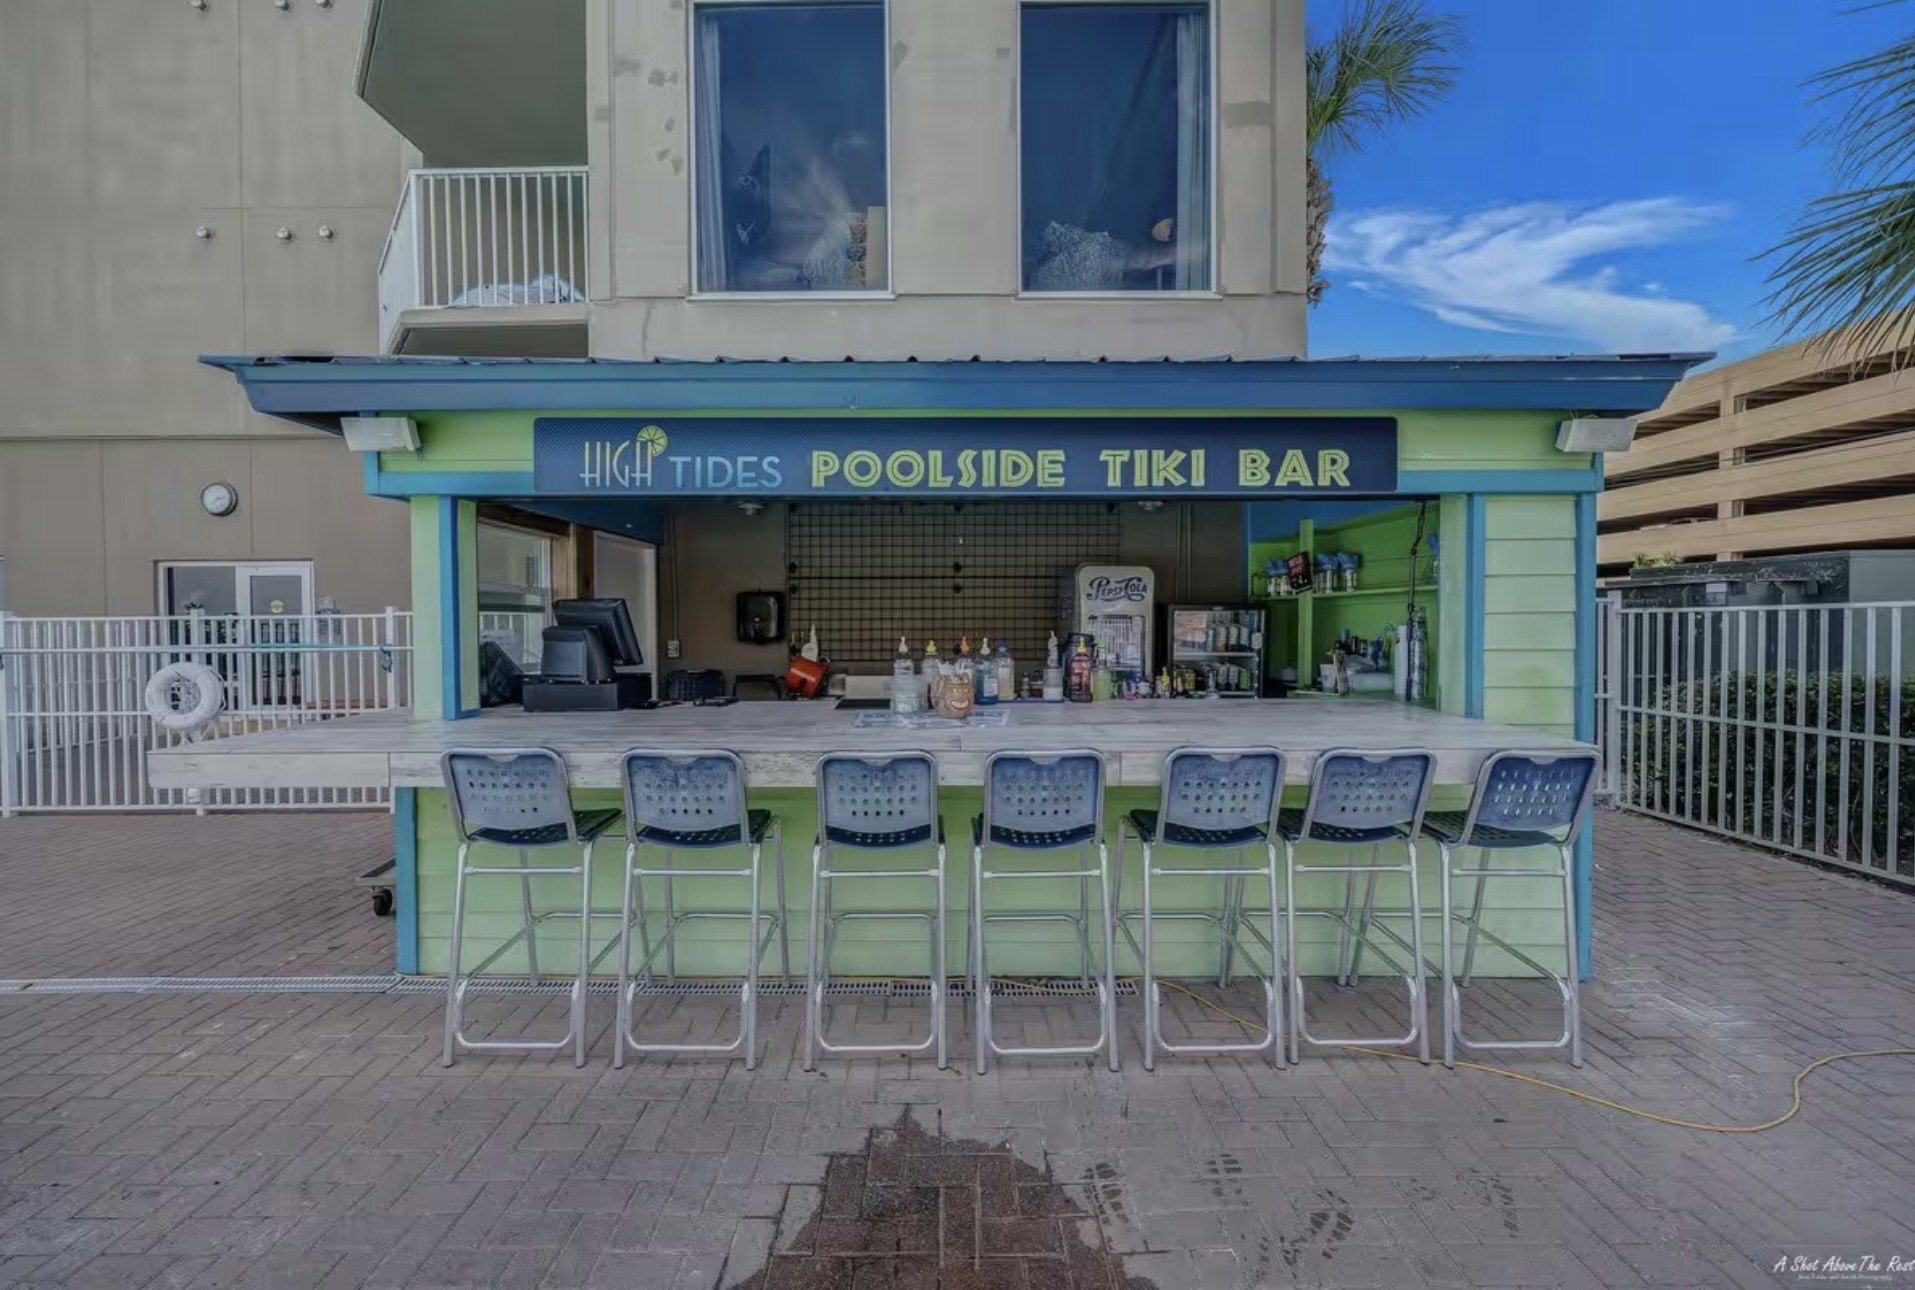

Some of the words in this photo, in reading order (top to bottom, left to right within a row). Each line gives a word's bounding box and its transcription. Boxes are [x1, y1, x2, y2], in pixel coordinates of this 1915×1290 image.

[579, 440, 653, 488] HIGH
[669, 455, 783, 488] TIDES
[812, 449, 1066, 488] POOLSIDE
[1099, 449, 1206, 487] TIKI
[1238, 449, 1351, 487] BAR
